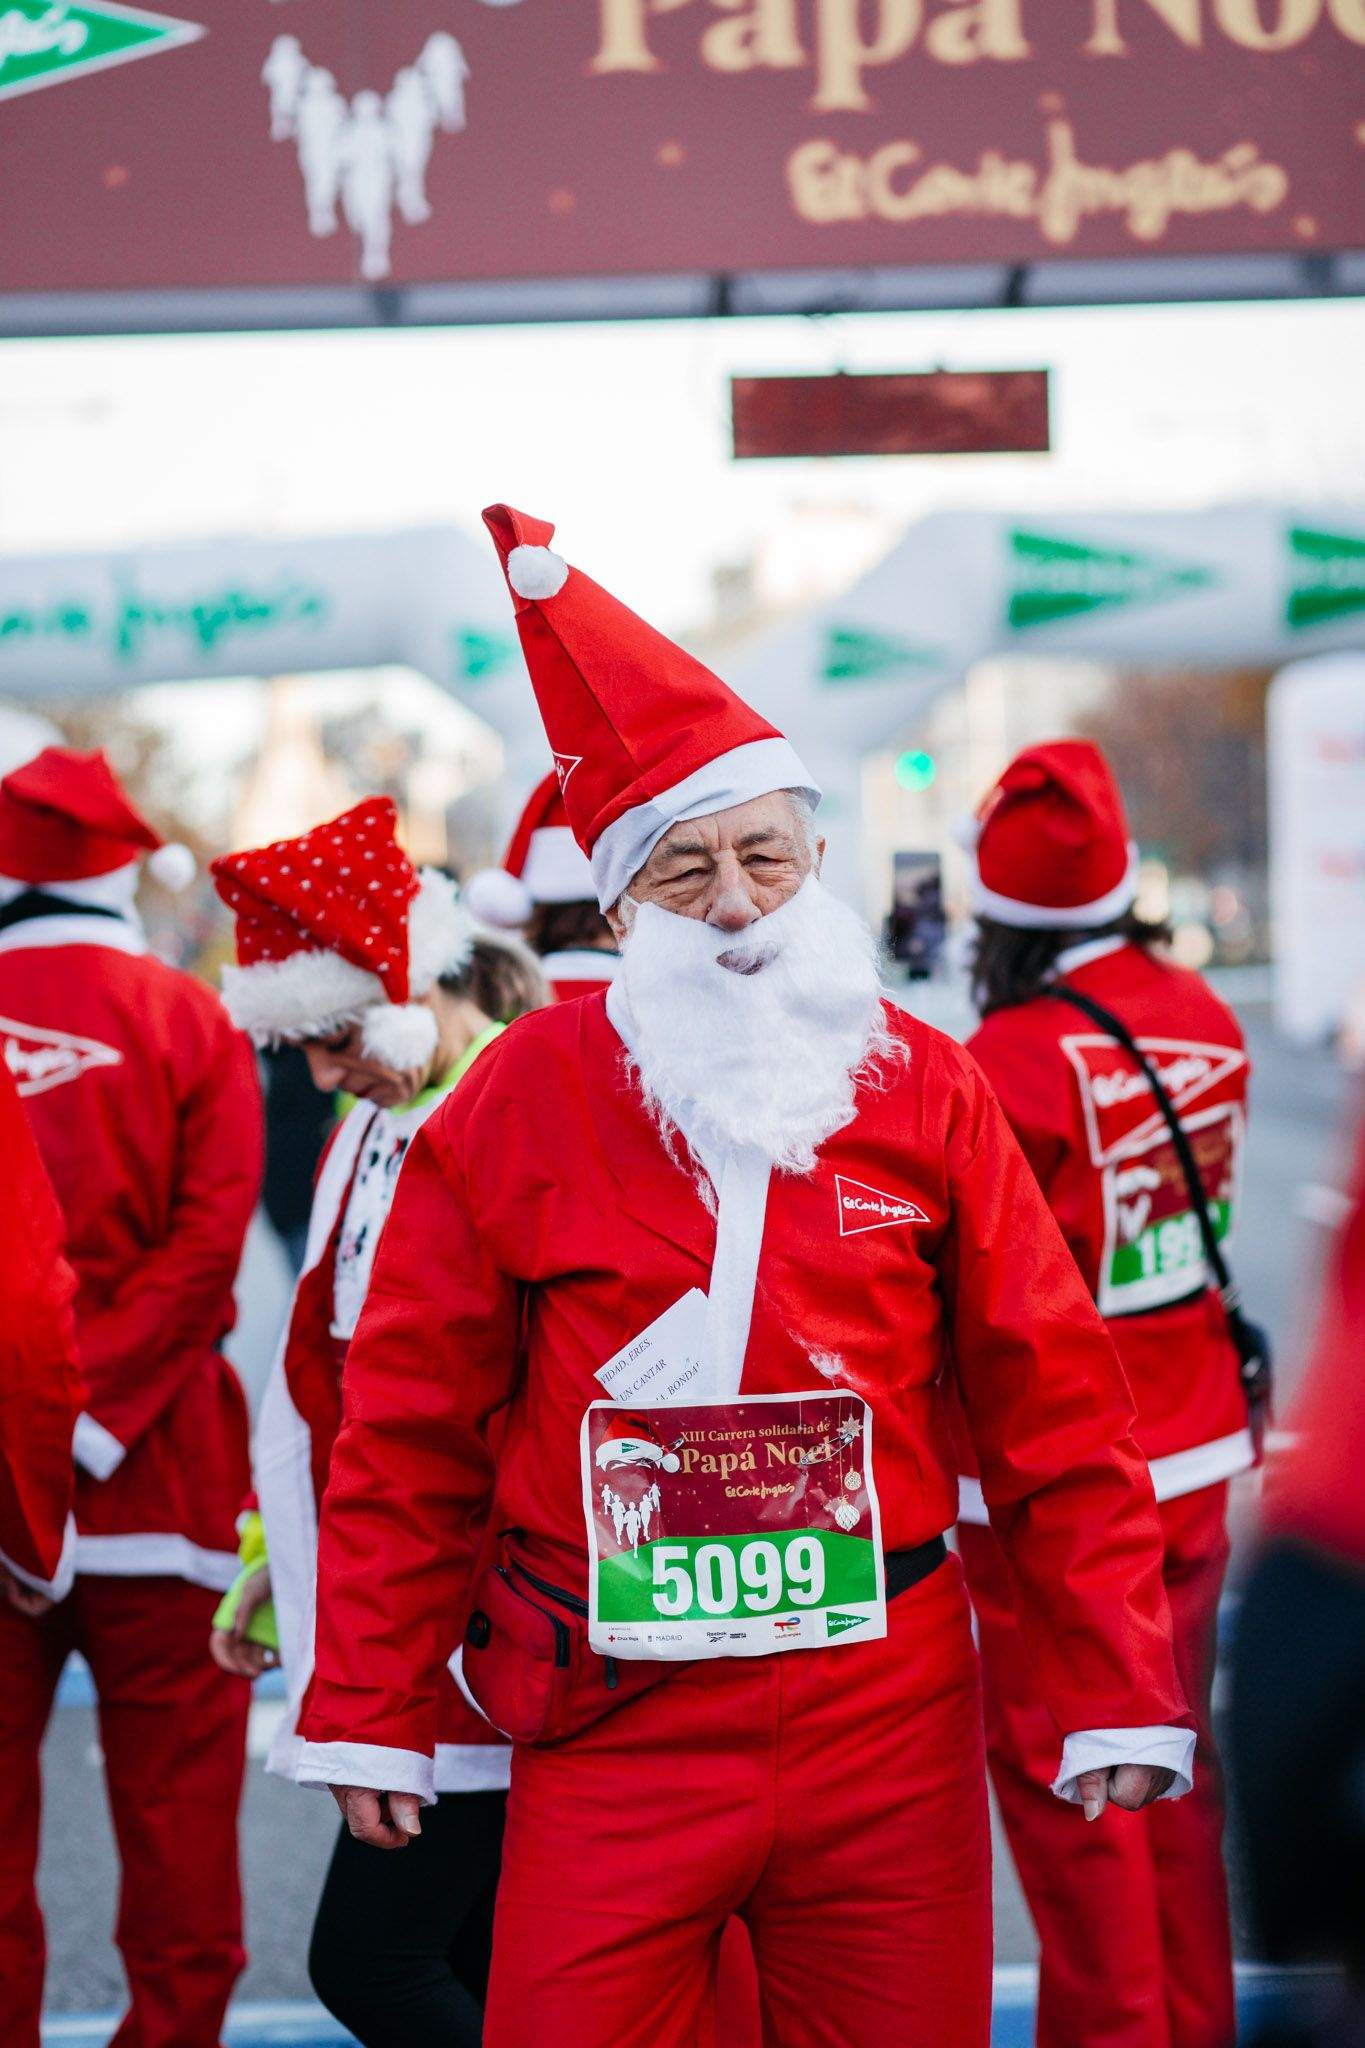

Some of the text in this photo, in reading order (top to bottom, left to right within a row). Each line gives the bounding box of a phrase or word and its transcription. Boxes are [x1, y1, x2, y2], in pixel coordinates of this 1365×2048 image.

[880, 1198, 915, 1218] Inglés
[632, 1358, 667, 1391] CANTAR
[681, 1431, 705, 1443] XIII
[708, 1428, 756, 1442] Carrera
[758, 1423, 815, 1438] solidaria
[680, 1435, 834, 1480] Papá Noel
[760, 1480, 795, 1500] Inglés
[652, 1536, 826, 1616] 5099
[655, 1634, 683, 1642] MADRID
